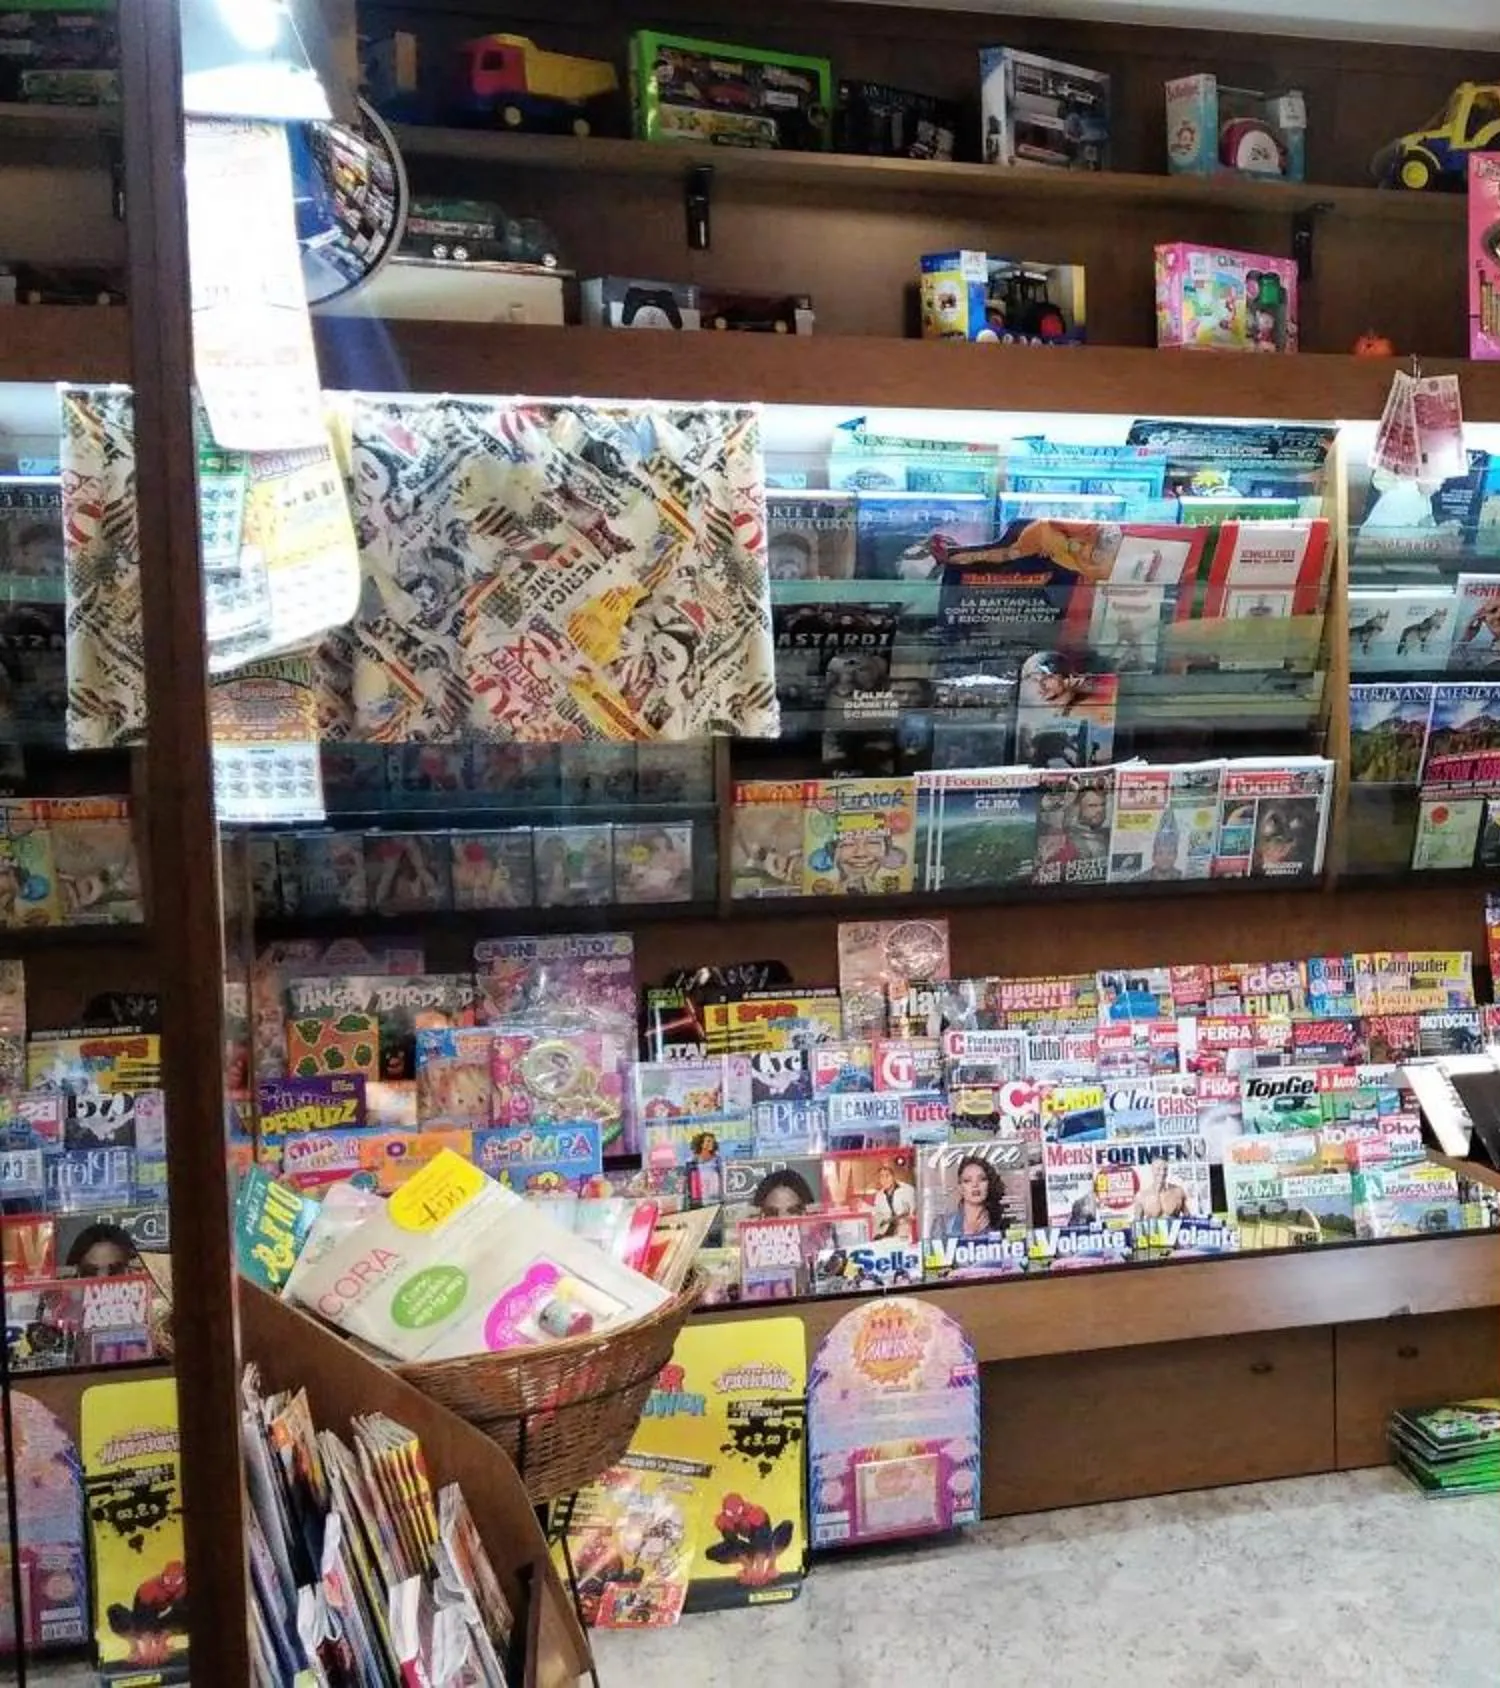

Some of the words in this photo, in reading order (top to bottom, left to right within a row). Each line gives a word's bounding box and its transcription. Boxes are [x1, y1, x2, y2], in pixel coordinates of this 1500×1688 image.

[1377, 957, 1449, 979] Computer
[1002, 983, 1071, 998] UBUNTU
[1198, 1025, 1252, 1042] FERRA
[1246, 1076, 1319, 1099] TopGe
[1096, 1147, 1136, 1165] FOR
[1036, 1228, 1125, 1255] Volante
[1156, 1218, 1239, 1247] Volante
[851, 1247, 920, 1273] Sella
[940, 1237, 1025, 1266] Volante
[317, 1247, 400, 1318] CORA
